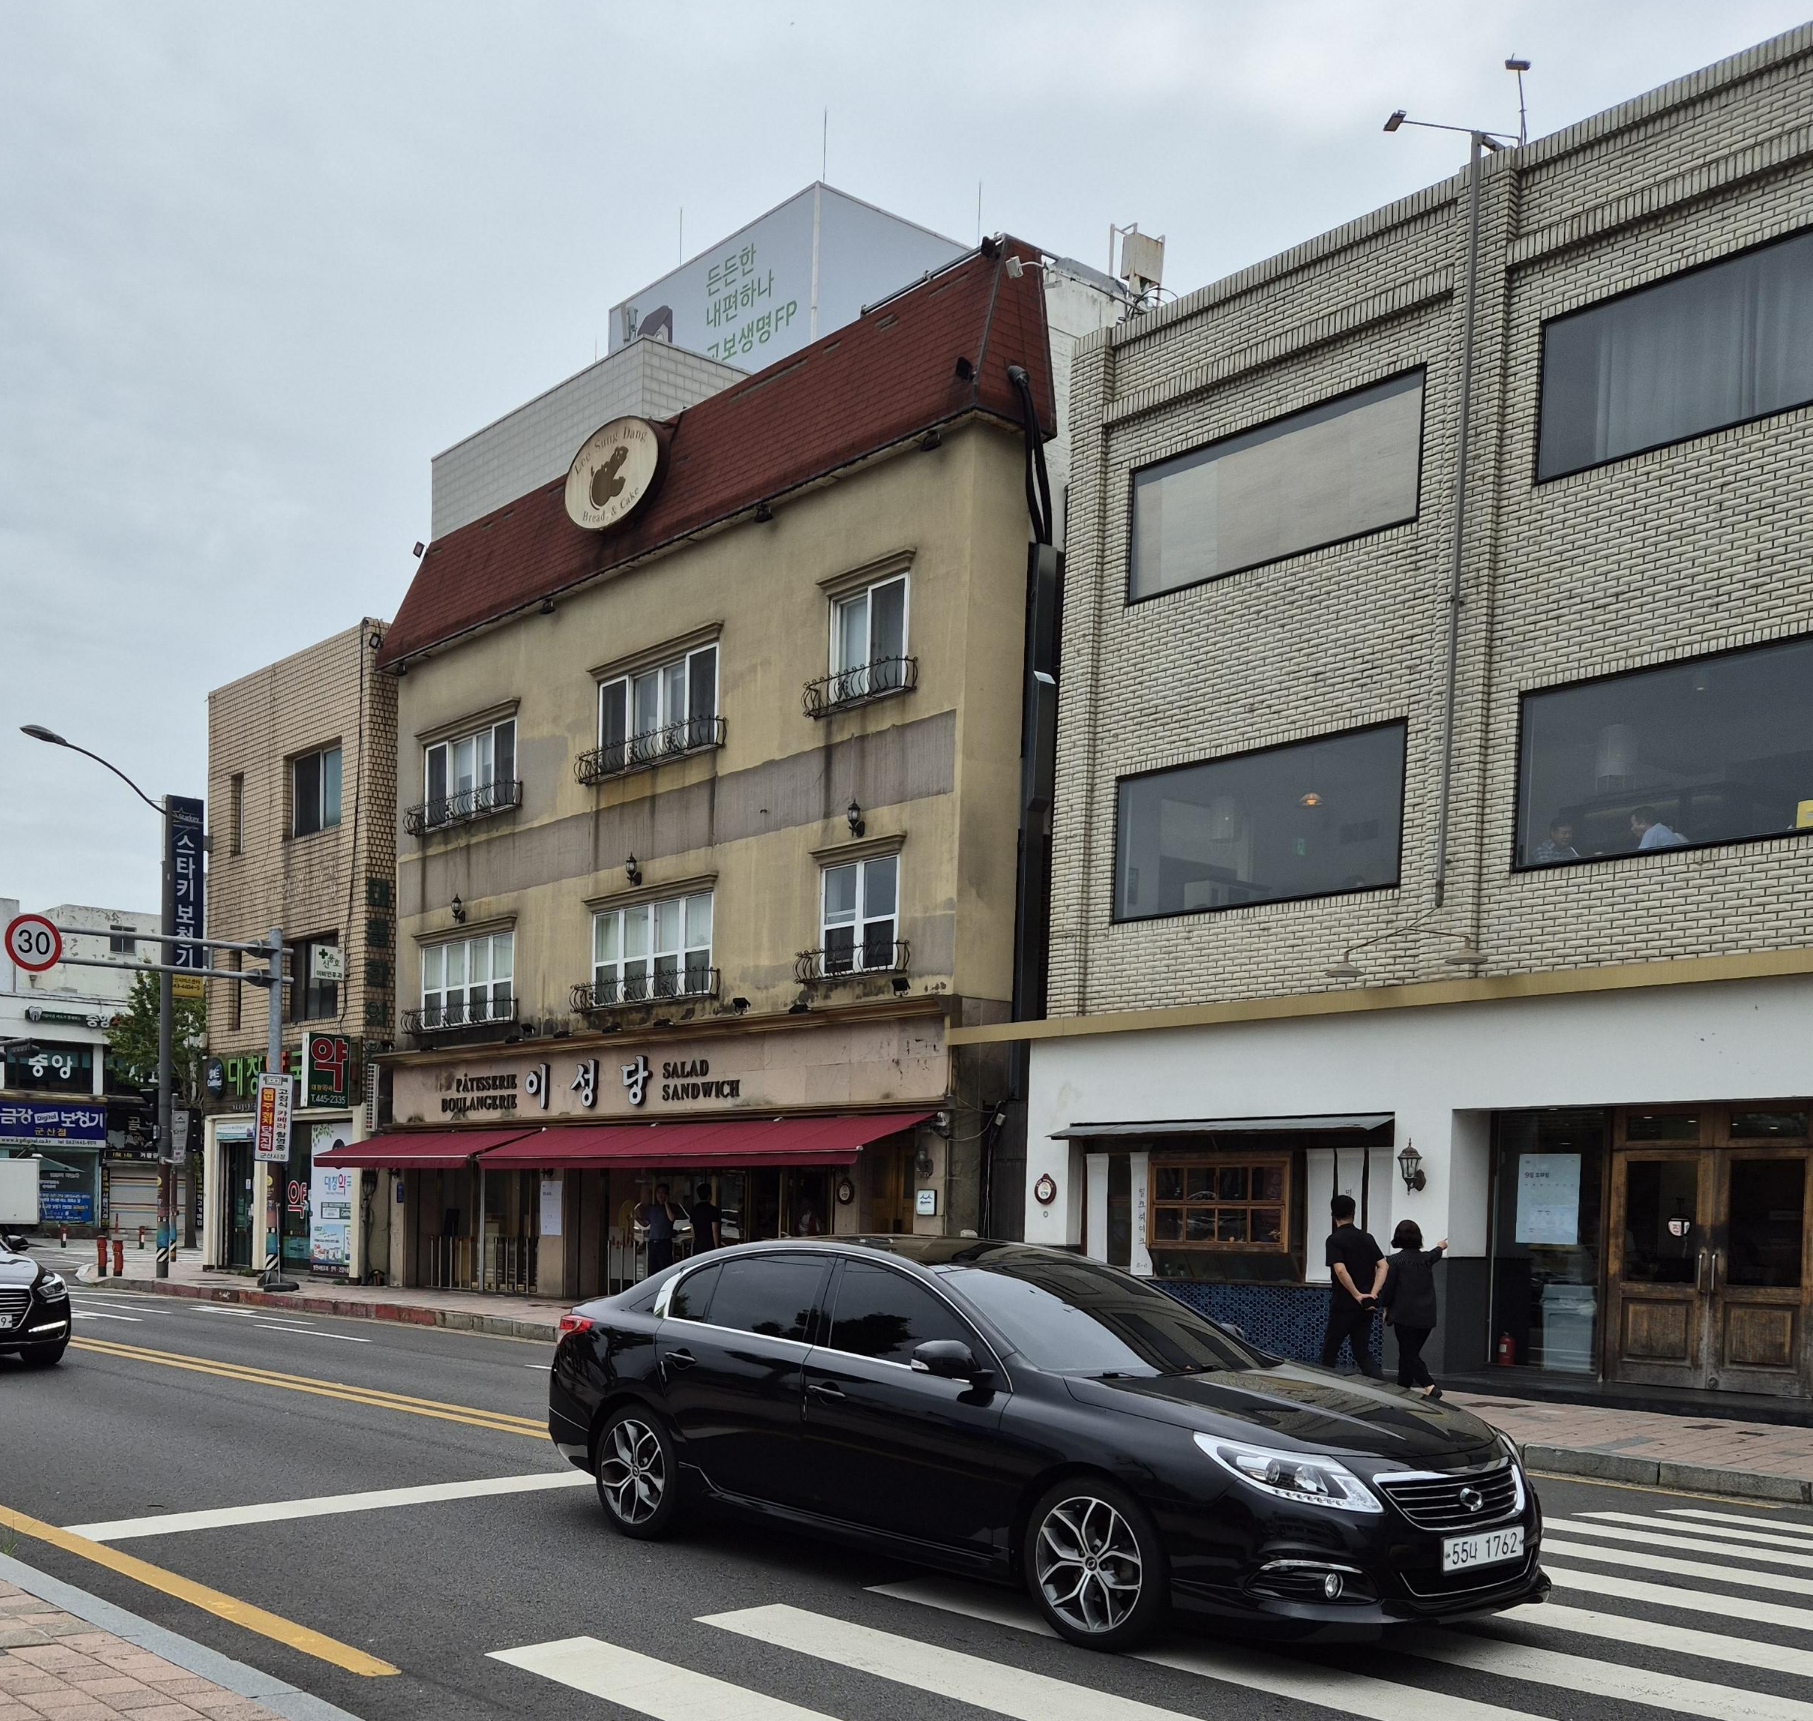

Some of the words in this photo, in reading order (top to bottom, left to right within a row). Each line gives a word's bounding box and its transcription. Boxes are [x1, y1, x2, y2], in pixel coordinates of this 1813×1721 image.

[706, 242, 756, 297] 든든한
[574, 453, 591, 475] Lee
[594, 432, 618, 449] Sung
[623, 426, 648, 443] Dang
[582, 510, 606, 523] Bread
[610, 505, 617, 517] &
[620, 486, 639, 509] Cake
[18, 929, 50, 955] 30
[86, 1013, 110, 1028] 중앙
[28, 1054, 73, 1079] 중앙
[311, 1037, 349, 1093] 약
[662, 1059, 710, 1079] SALAD
[455, 1073, 517, 1093] PÂTISSERIE
[662, 1079, 741, 1102] SANDWICH
[278, 1088, 289, 1108] 고정식
[441, 1094, 517, 1113] BOULANGERIE
[0, 1108, 34, 1125] 금강
[37, 1113, 57, 1122] Digital
[61, 1111, 103, 1128] 보청기
[277, 1110, 287, 1130] 카메라
[287, 1180, 308, 1220] 약
[1452, 1541, 1478, 1565] 55너
[1485, 1532, 1517, 1558] 1762
